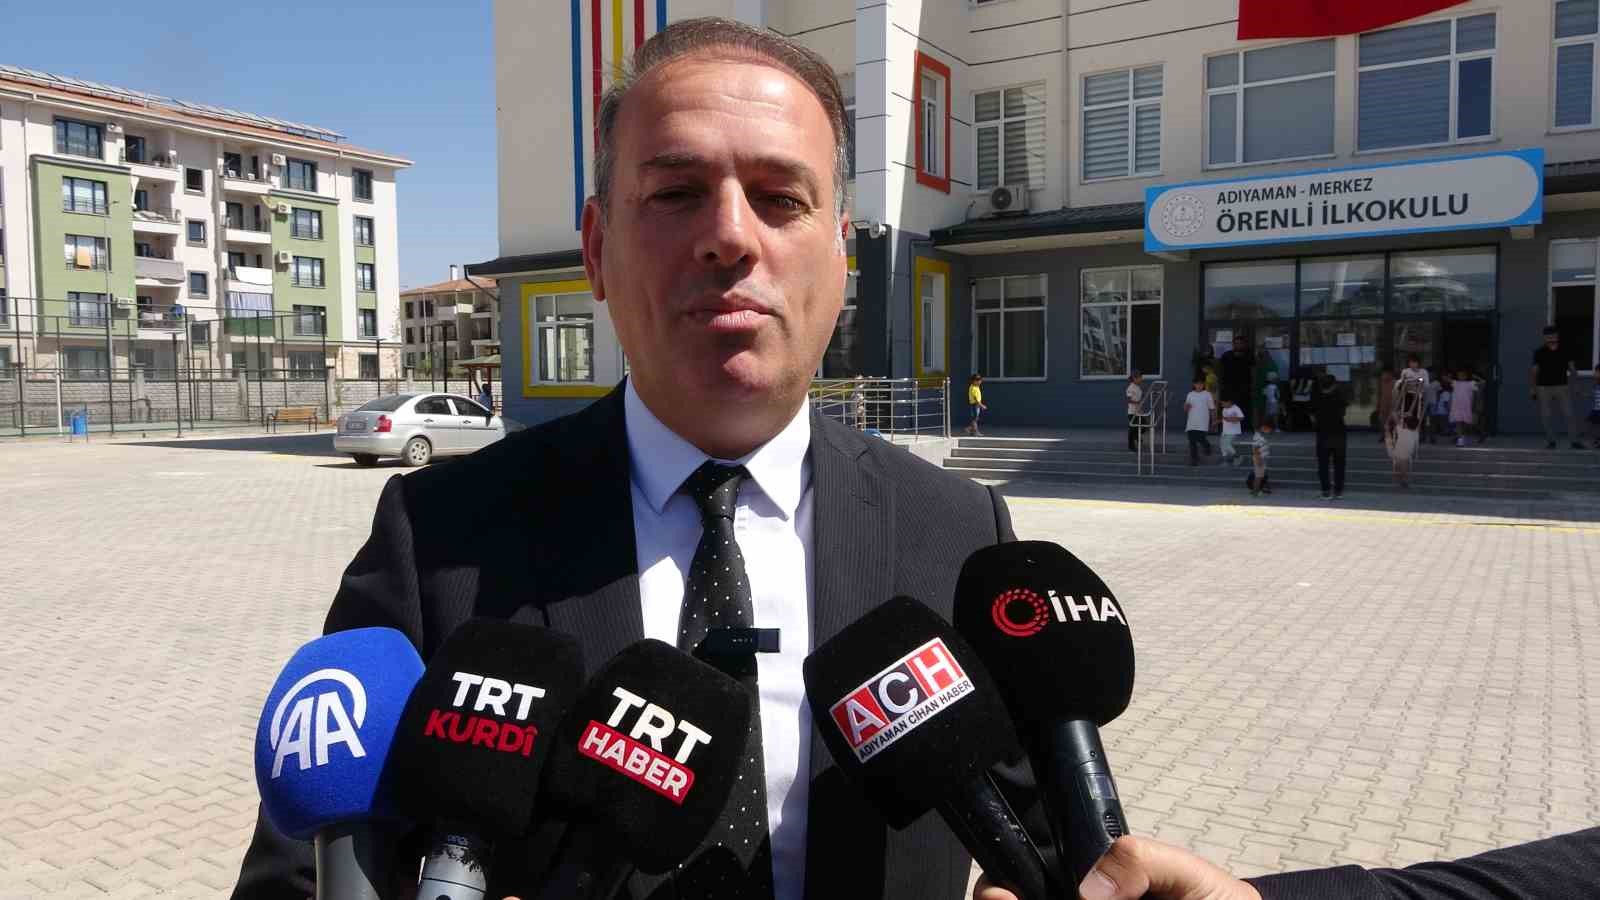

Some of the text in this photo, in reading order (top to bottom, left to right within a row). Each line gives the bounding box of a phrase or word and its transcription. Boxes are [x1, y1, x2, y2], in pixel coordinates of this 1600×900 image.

[1216, 202, 1313, 233] ÖRENLİ
[1322, 193, 1469, 226] İLKOKULU
[1217, 185, 1297, 205] ADIYAMAN
[1309, 178, 1373, 196] MERKEZ
[1048, 589, 1127, 626] İHA
[451, 671, 546, 721] TRT
[612, 686, 712, 764] TRT
[845, 646, 960, 745] ACH
[859, 680, 972, 760] ADIYAMAN CİHAN HABER
[271, 691, 367, 779] AA
[424, 709, 539, 758] KURDÎ
[583, 726, 688, 797] HABER
